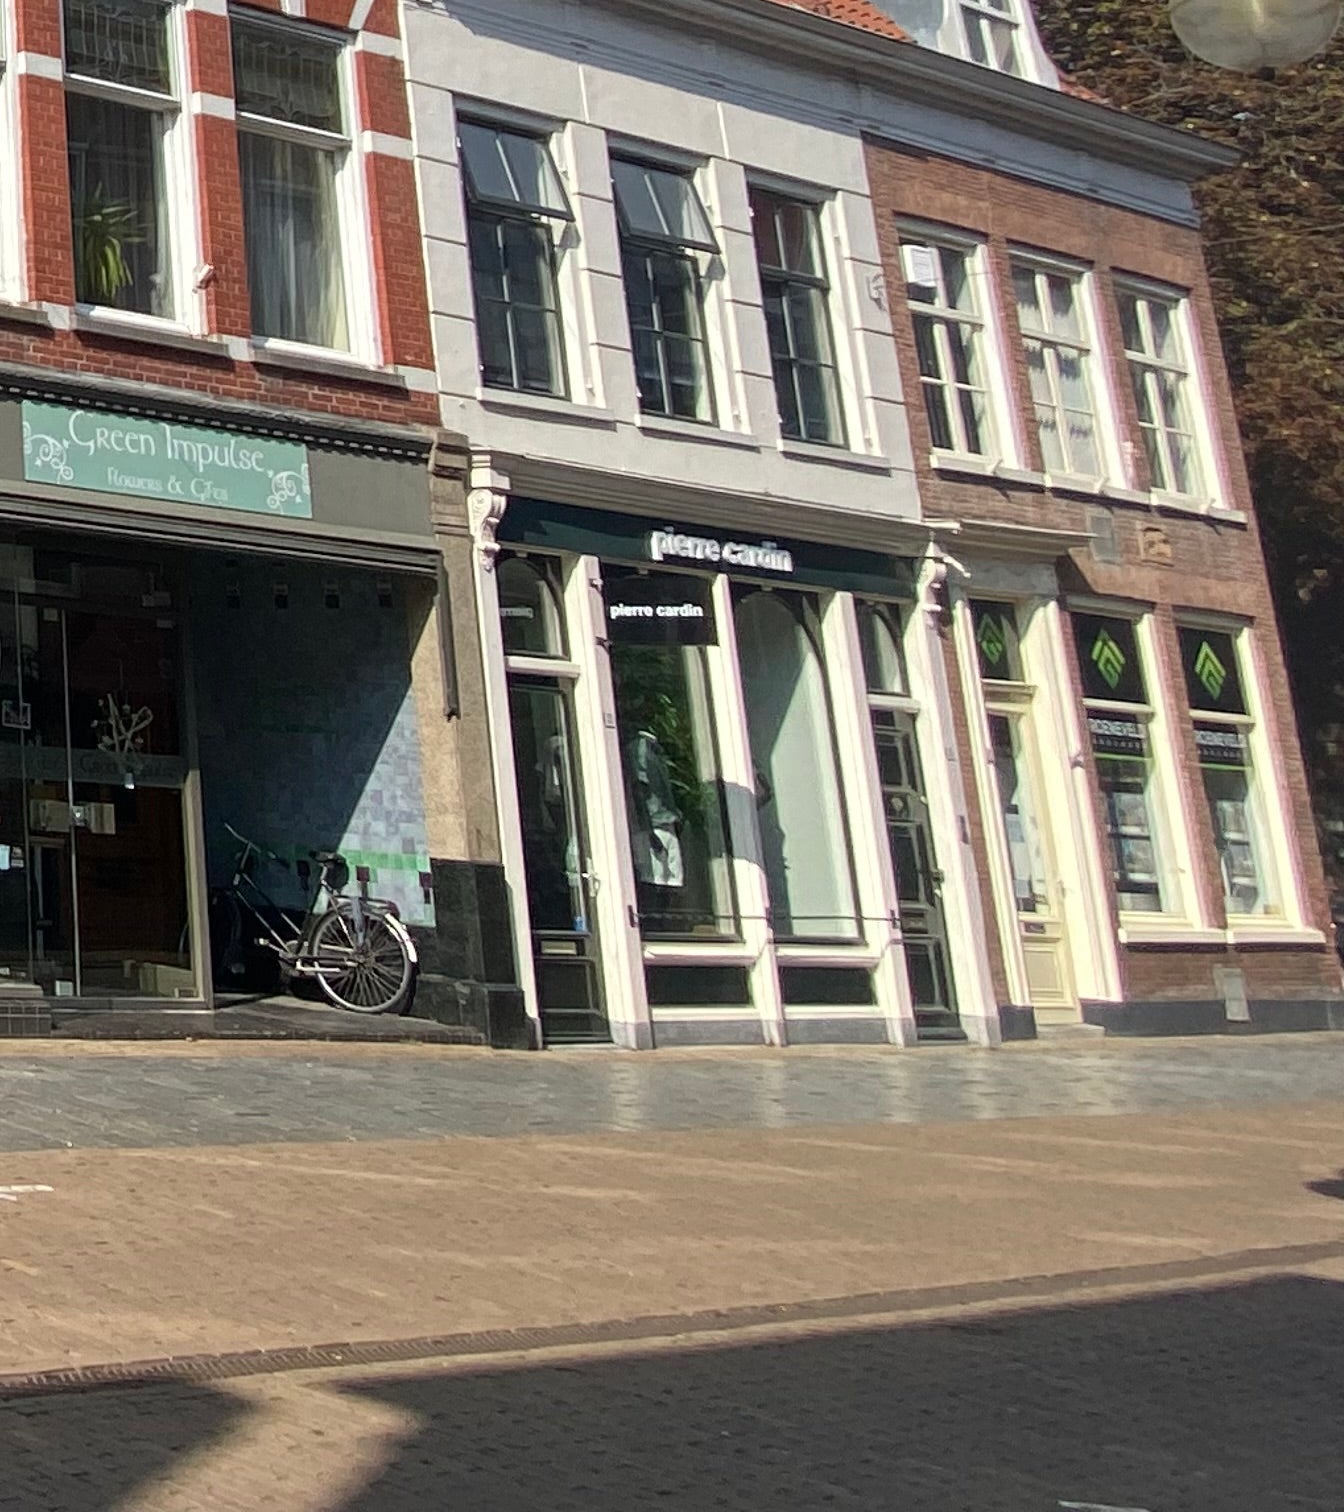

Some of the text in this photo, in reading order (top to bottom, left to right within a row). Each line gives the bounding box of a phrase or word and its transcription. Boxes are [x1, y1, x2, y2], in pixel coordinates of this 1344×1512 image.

[69, 410, 265, 473] Green Impulse
[650, 526, 721, 562] pierre
[609, 603, 704, 620] pierre cardin
